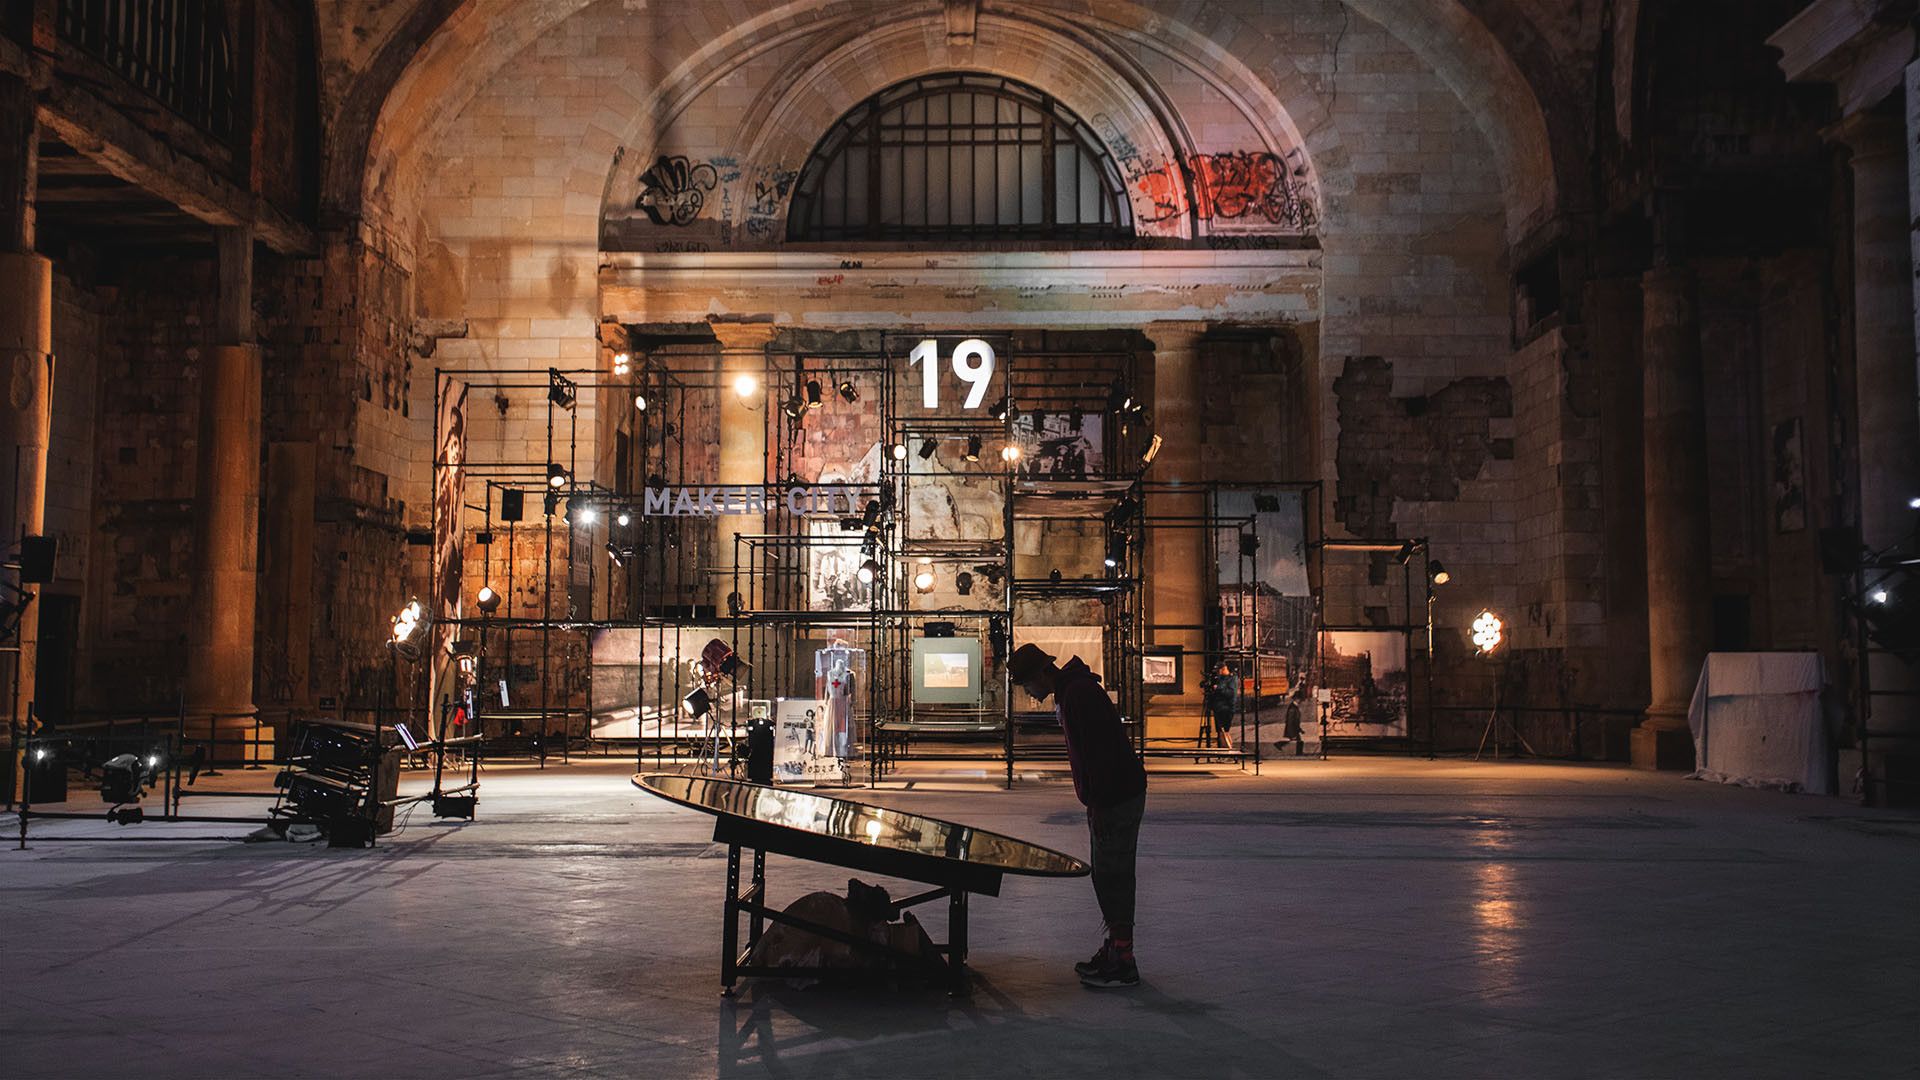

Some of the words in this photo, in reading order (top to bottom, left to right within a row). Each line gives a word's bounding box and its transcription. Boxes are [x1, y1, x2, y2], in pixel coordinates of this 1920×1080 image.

[910, 339, 995, 409] 19
[644, 486, 766, 516] MAKER
[787, 486, 861, 516] CITY
